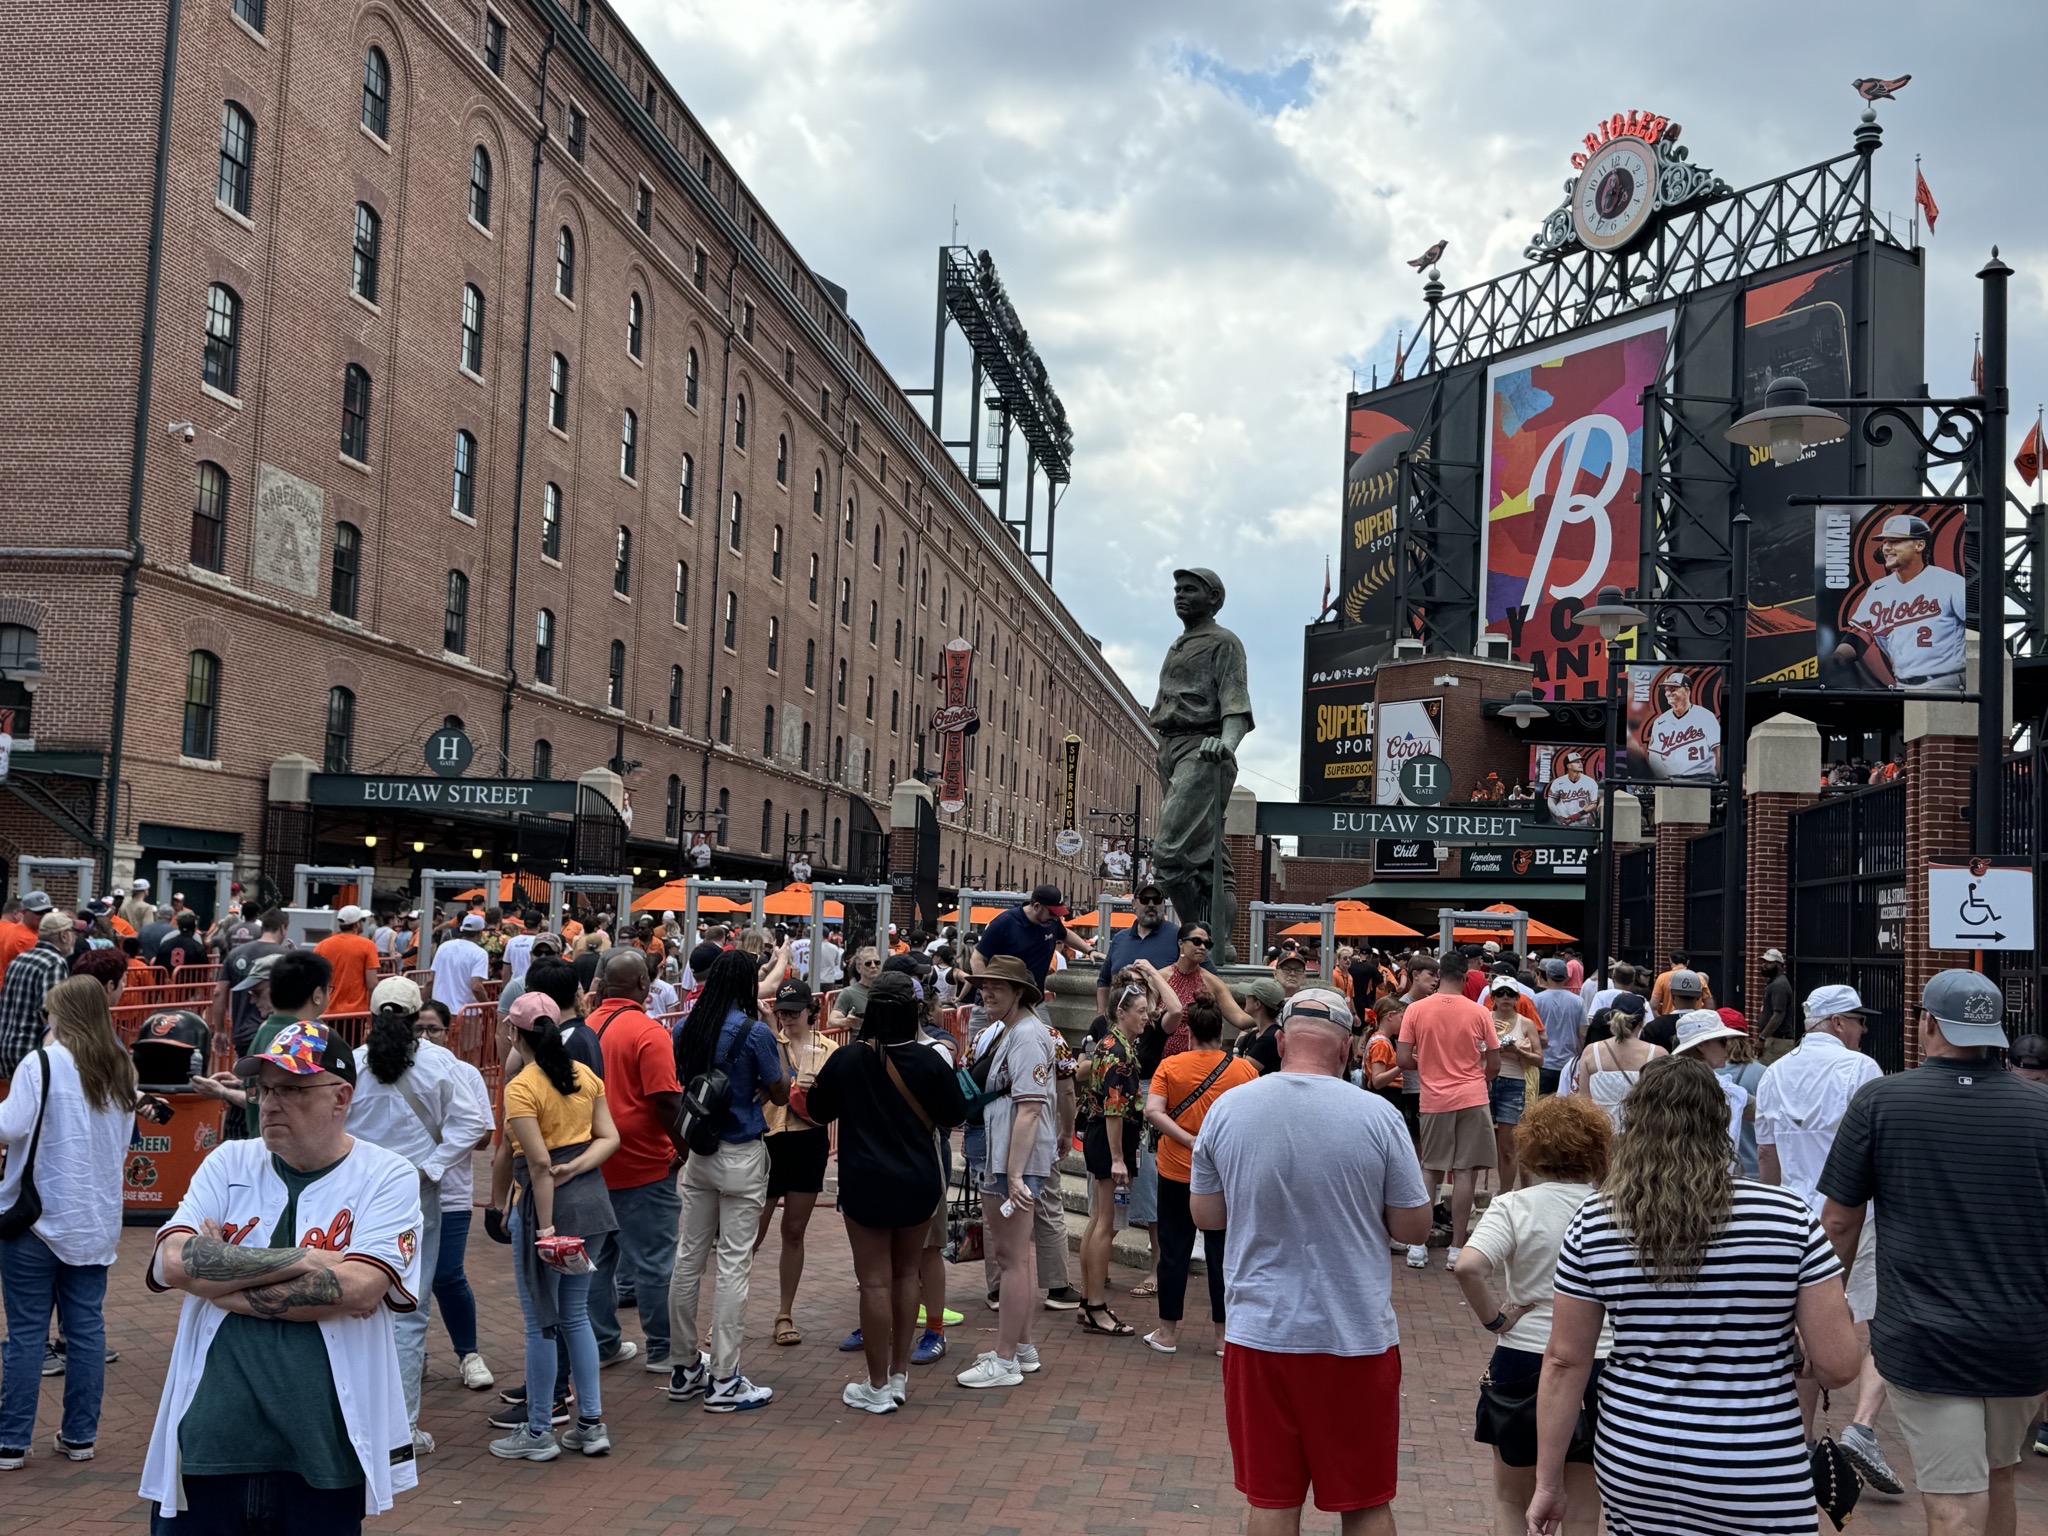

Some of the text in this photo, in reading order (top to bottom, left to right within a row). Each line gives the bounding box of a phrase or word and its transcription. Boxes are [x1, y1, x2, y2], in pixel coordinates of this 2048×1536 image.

[1570, 109, 1669, 170] ORIOLES
[1610, 156, 1620, 168] 12
[1588, 179, 1599, 191] 10
[1825, 514, 1850, 590] GUNNAR
[1868, 594, 1942, 632] Orioles
[1916, 626, 1932, 647] 2
[951, 653, 966, 704] TEAM
[1634, 671, 1650, 702] HAYS
[933, 708, 977, 729] Orioles
[436, 736, 460, 761] H
[1387, 736, 1432, 758] Coors
[1687, 746, 1705, 761] 21
[945, 734, 965, 797] STORE
[1413, 764, 1438, 788] H
[364, 782, 533, 805] EUTAW STREET
[1066, 745, 1076, 826] SUPERBOOK
[1333, 812, 1522, 836] EUTAW STREET
[1393, 844, 1420, 858] Chill
[1470, 852, 1502, 862] Hometown
[1470, 862, 1501, 873] Favorites
[171, 947, 184, 967] 8
[1963, 1012, 1993, 1020] BRAVES
[138, 1191, 163, 1202] RECYCLE
